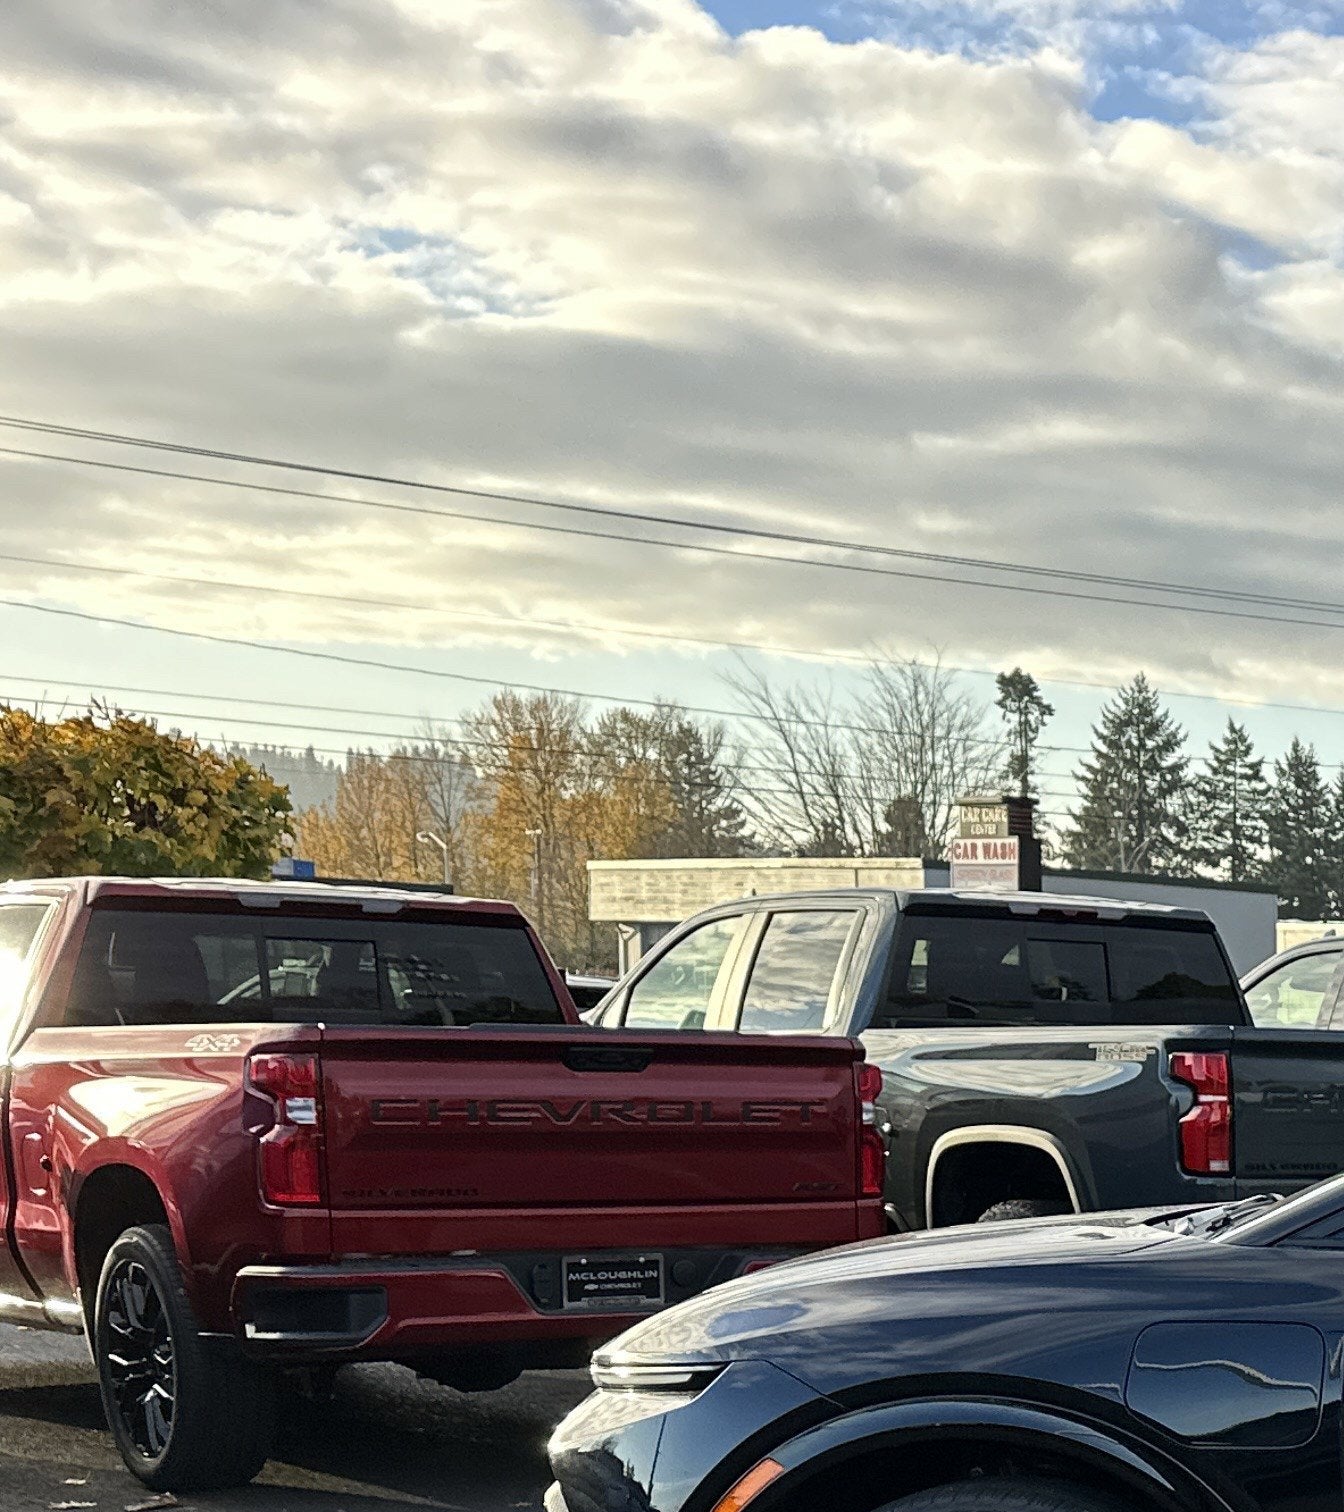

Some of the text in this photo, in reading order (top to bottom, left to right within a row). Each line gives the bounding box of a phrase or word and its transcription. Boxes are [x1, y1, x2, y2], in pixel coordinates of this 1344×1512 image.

[953, 842, 1017, 860] CAR WASH
[370, 1097, 829, 1127] CHEVROLET
[567, 1269, 659, 1281] MCLOUGHLIN
